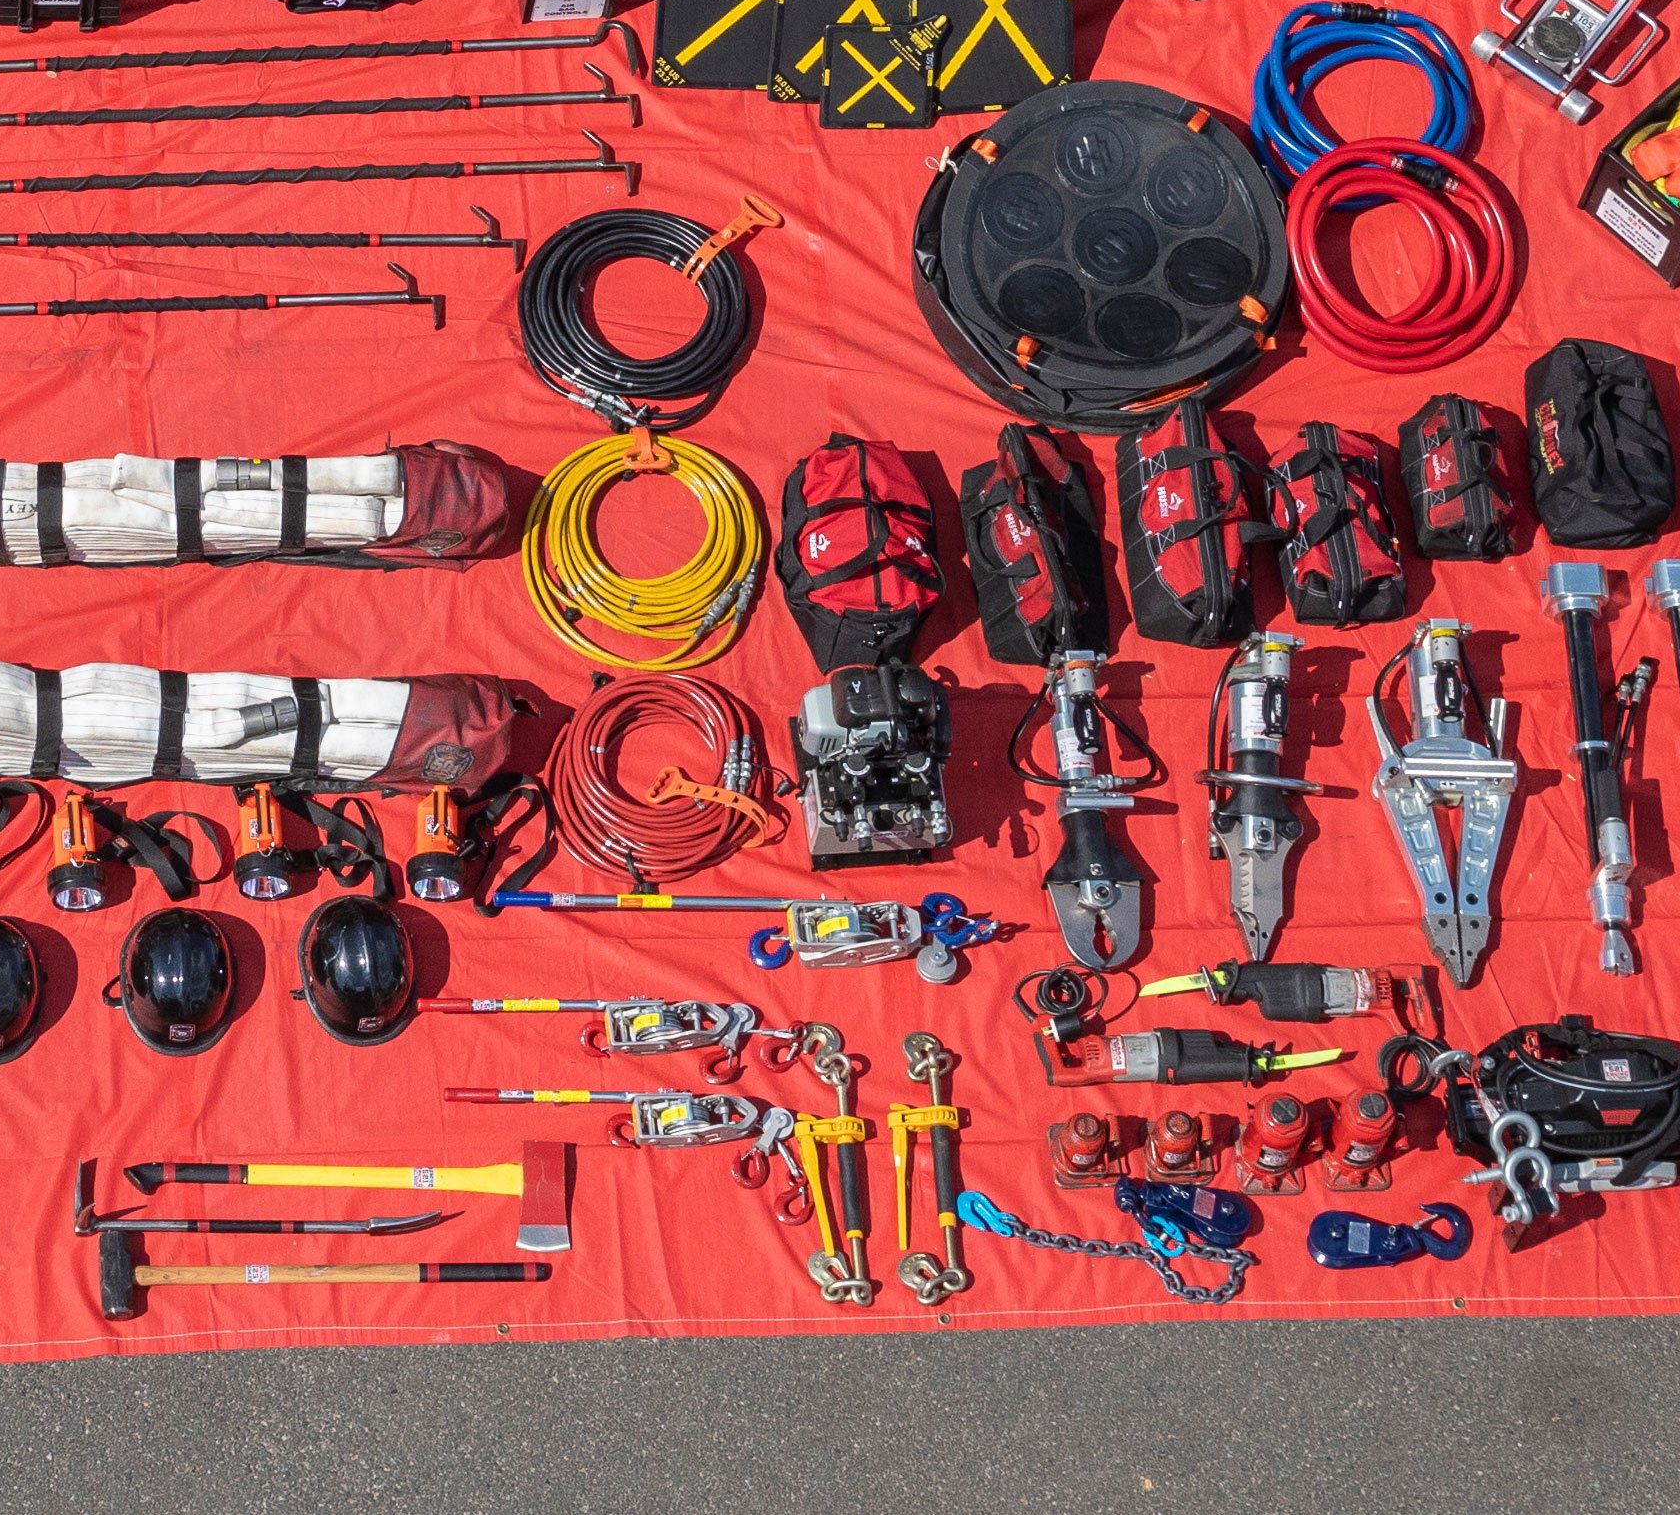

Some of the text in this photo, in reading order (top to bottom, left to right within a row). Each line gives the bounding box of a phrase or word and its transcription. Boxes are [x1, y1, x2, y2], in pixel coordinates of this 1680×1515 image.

[1612, 197, 1662, 240] RESCUE ENGINE
[1538, 402, 1565, 470] CHIMNEY
[1431, 453, 1441, 482] HUSKY
[1156, 486, 1169, 518] HUSKY
[809, 532, 819, 559] HUSKY
[1004, 512, 1022, 548] HUSKY
[850, 680, 862, 694] A
